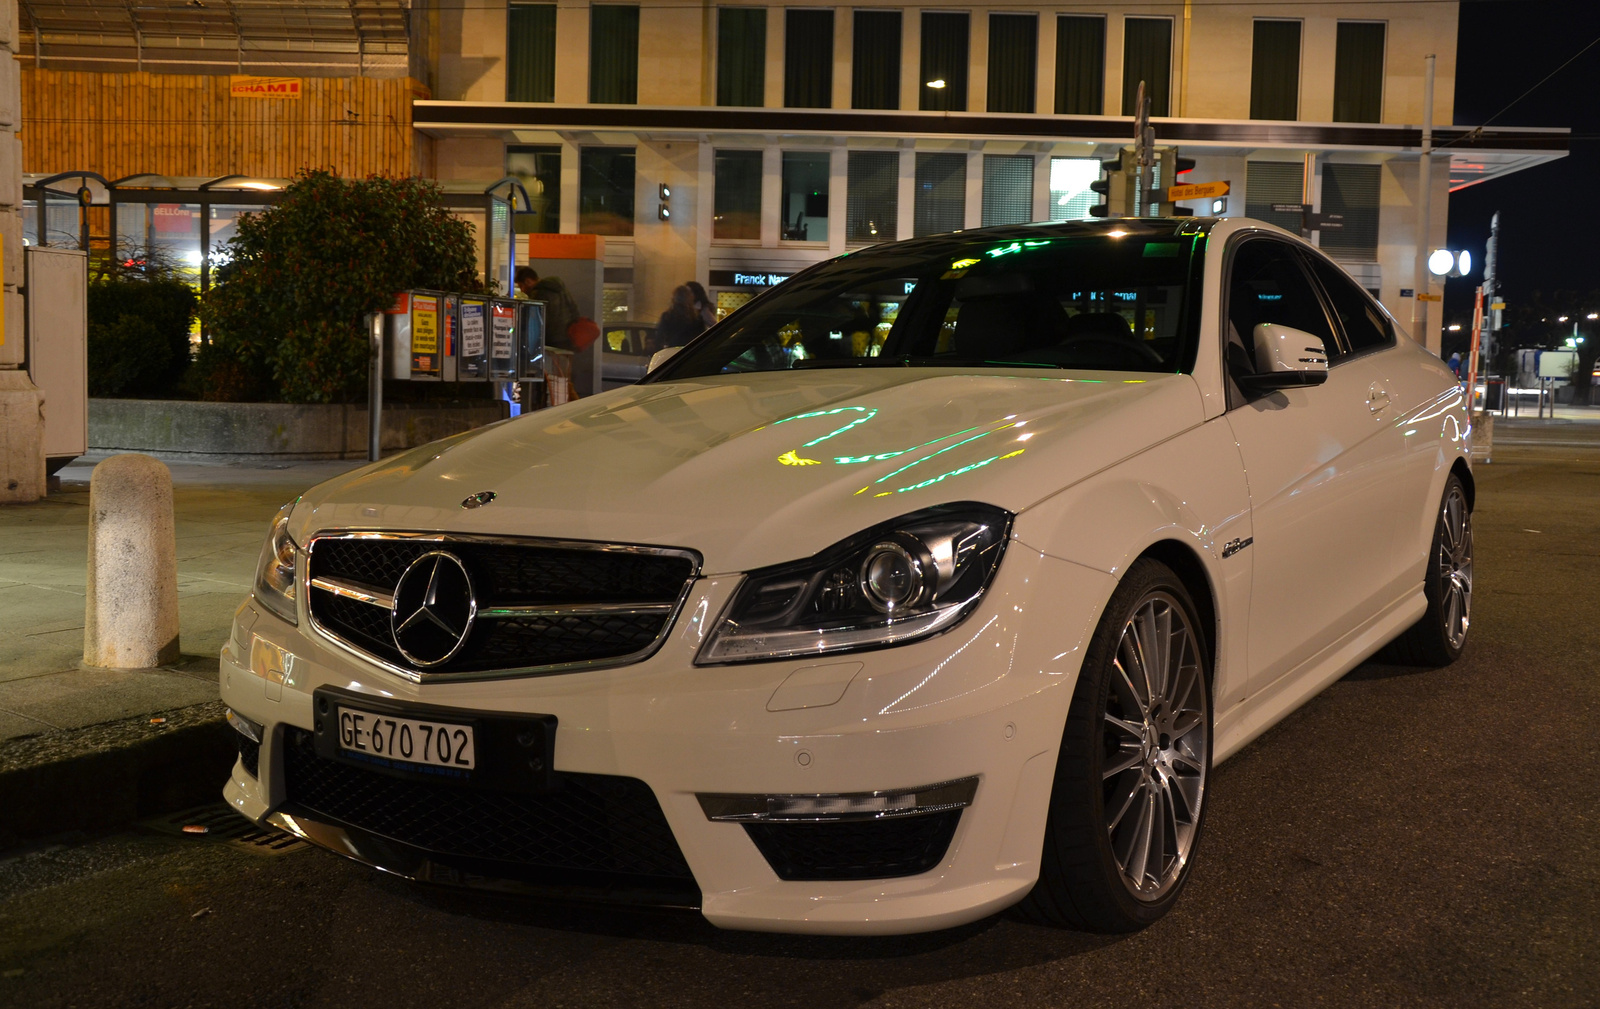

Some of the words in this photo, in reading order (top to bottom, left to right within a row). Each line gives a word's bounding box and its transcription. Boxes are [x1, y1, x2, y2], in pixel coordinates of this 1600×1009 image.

[1185, 187, 1194, 196] des
[1195, 186, 1215, 196] Bergues
[735, 273, 766, 285] Franck
